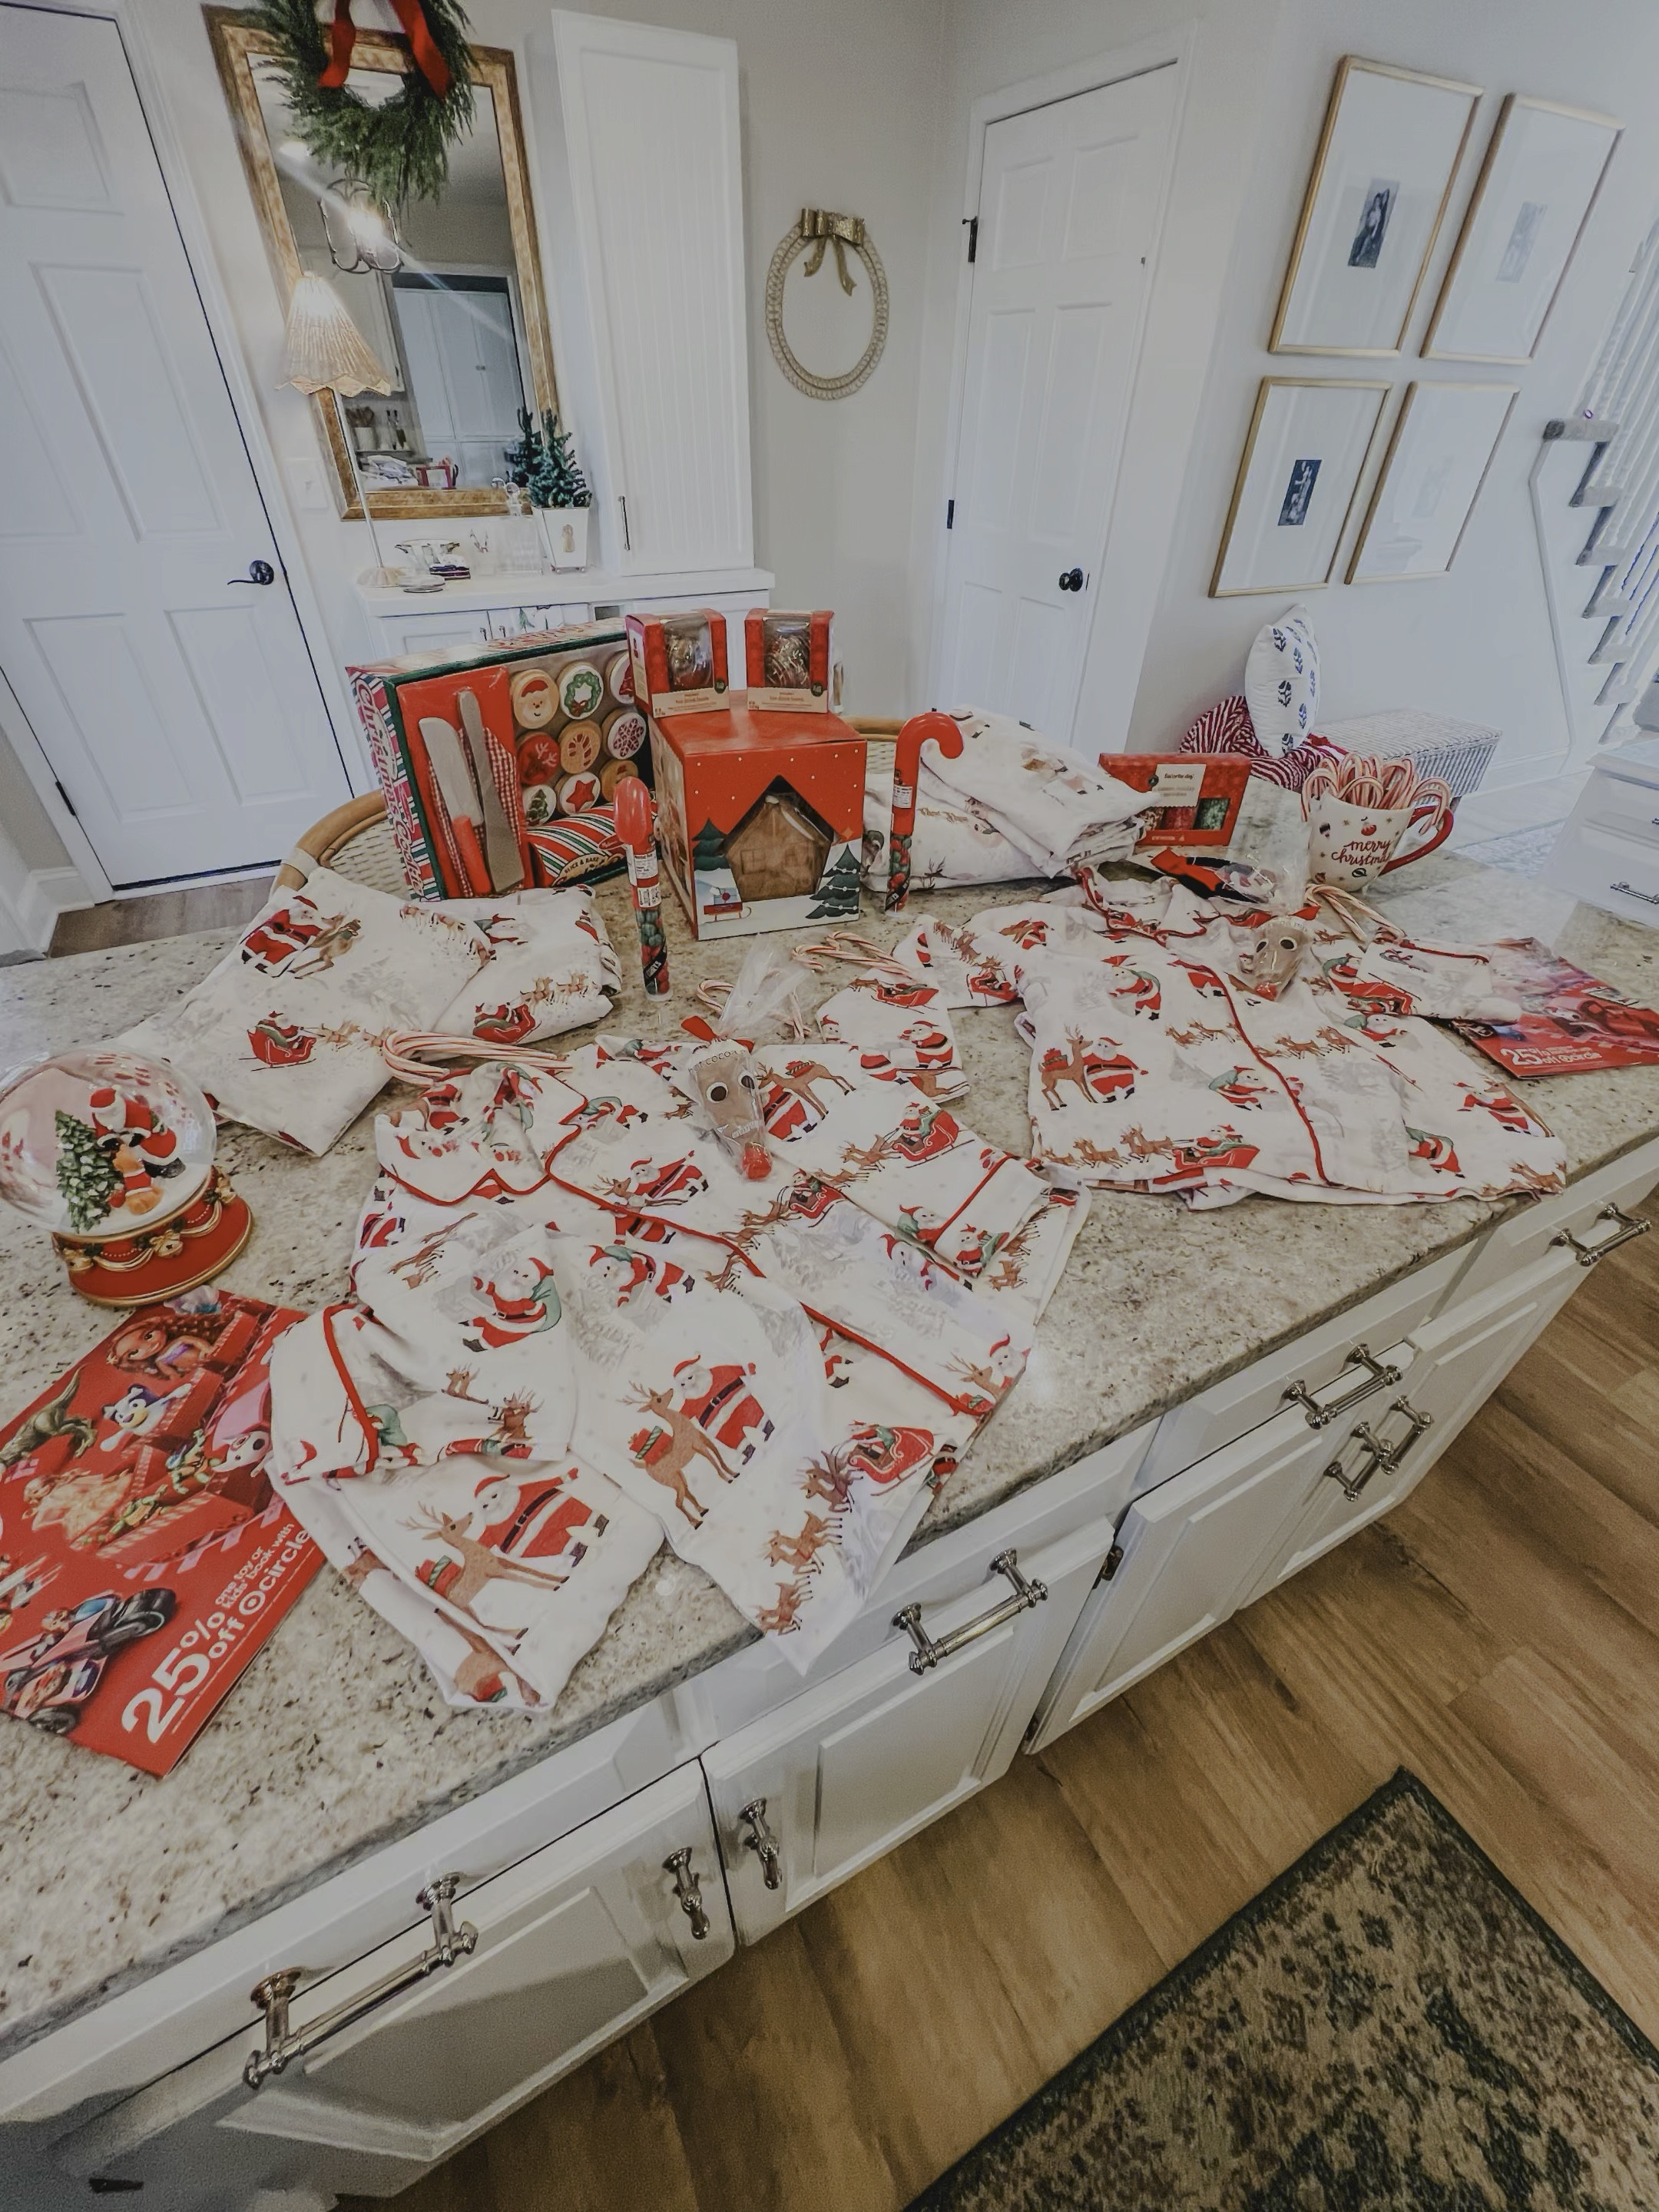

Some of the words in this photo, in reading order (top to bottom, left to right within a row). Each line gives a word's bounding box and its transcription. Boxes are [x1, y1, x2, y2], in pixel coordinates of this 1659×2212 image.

[357, 683, 399, 815] Christmas
[396, 823, 422, 895] Cookie
[1343, 840, 1391, 859] merry
[1500, 1047, 1551, 1065] 25%
[233, 1560, 253, 1580] toy
[251, 1546, 263, 1560] or
[246, 1549, 276, 1580] book
[272, 1524, 295, 1547] with
[208, 1616, 245, 1659] off
[259, 1529, 310, 1591] circle
[121, 1611, 225, 1743] 25%
